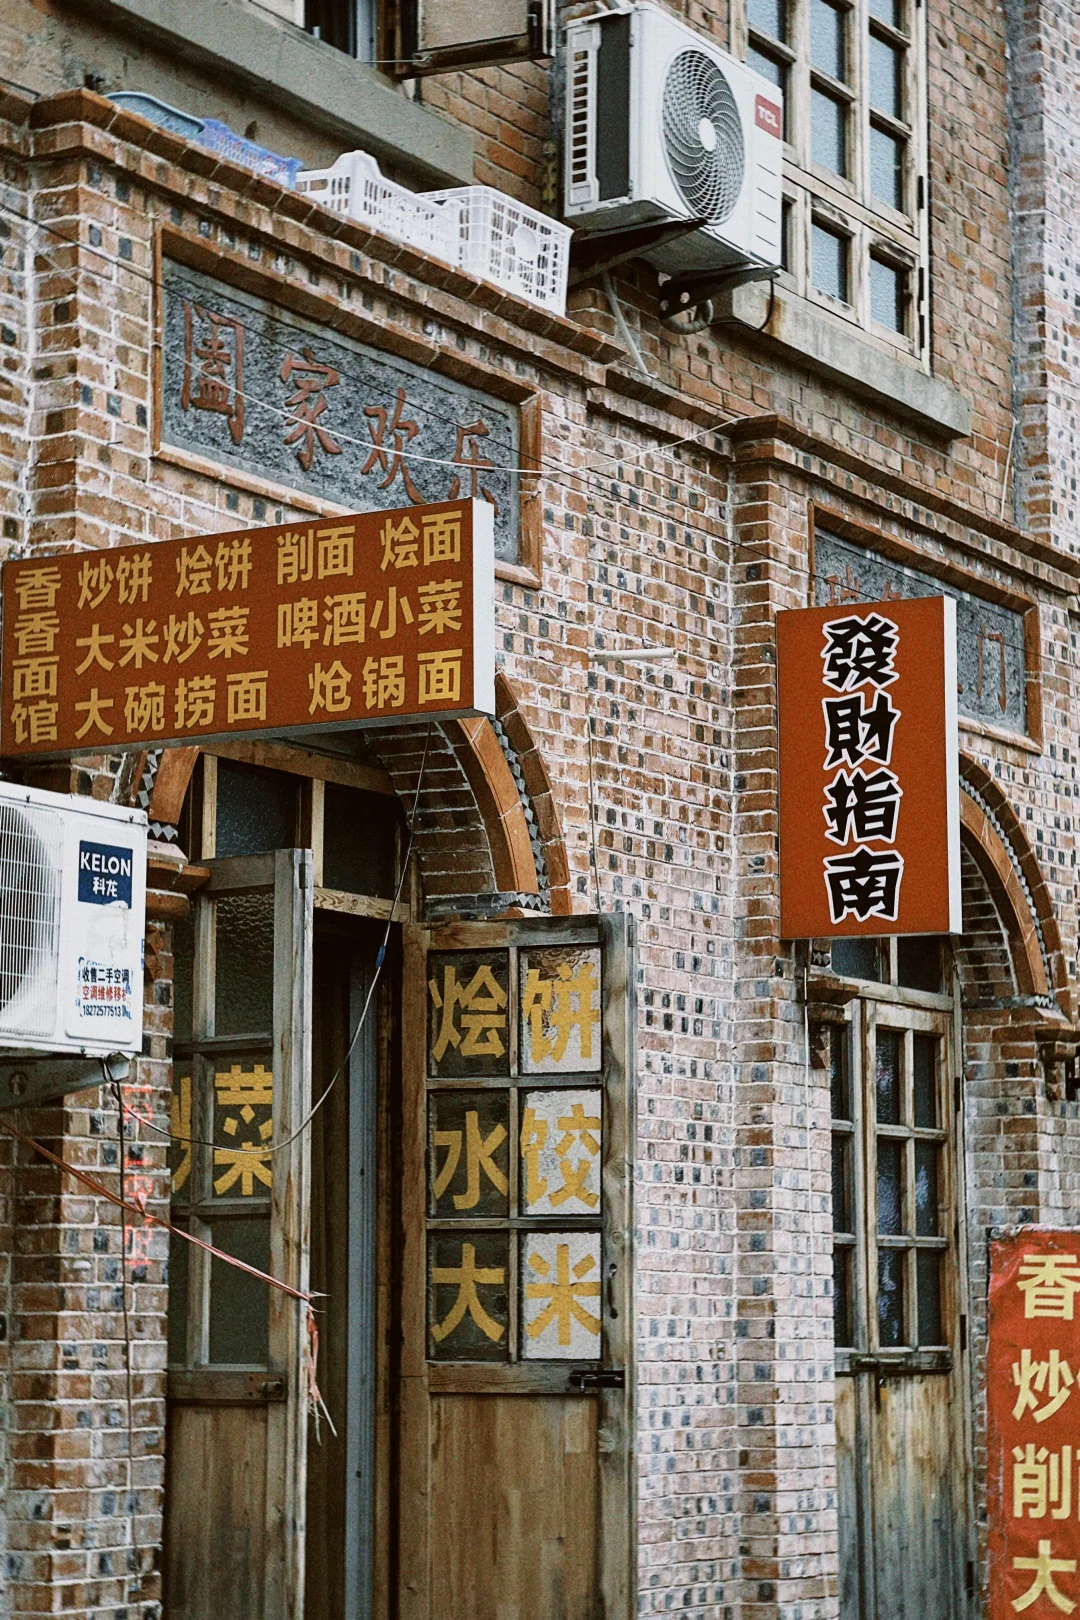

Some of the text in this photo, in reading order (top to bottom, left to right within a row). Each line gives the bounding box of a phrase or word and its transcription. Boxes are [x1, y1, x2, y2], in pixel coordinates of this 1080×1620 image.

[757, 104, 779, 128] TCL
[77, 510, 462, 611] 炒饼 烩饼 削面 烩面
[11, 565, 62, 745] 香香面馆
[75, 580, 463, 676] 大米炒菜 啤酒小菜
[74, 648, 463, 740] 大碗捞面 炝锅面
[820, 612, 904, 925] 發財指南
[80, 851, 131, 877] KELON
[92, 876, 118, 898] 科龙
[82, 1004, 121, 1017] 18272577513
[428, 961, 600, 1064] 烩饼
[432, 1103, 600, 1210] 水饺
[431, 1242, 600, 1346] 大米
[1016, 1254, 1080, 1320] 香
[1011, 1348, 1080, 1423] 炒
[1011, 1443, 1080, 1520] 削
[1011, 1539, 1078, 1615] 大
